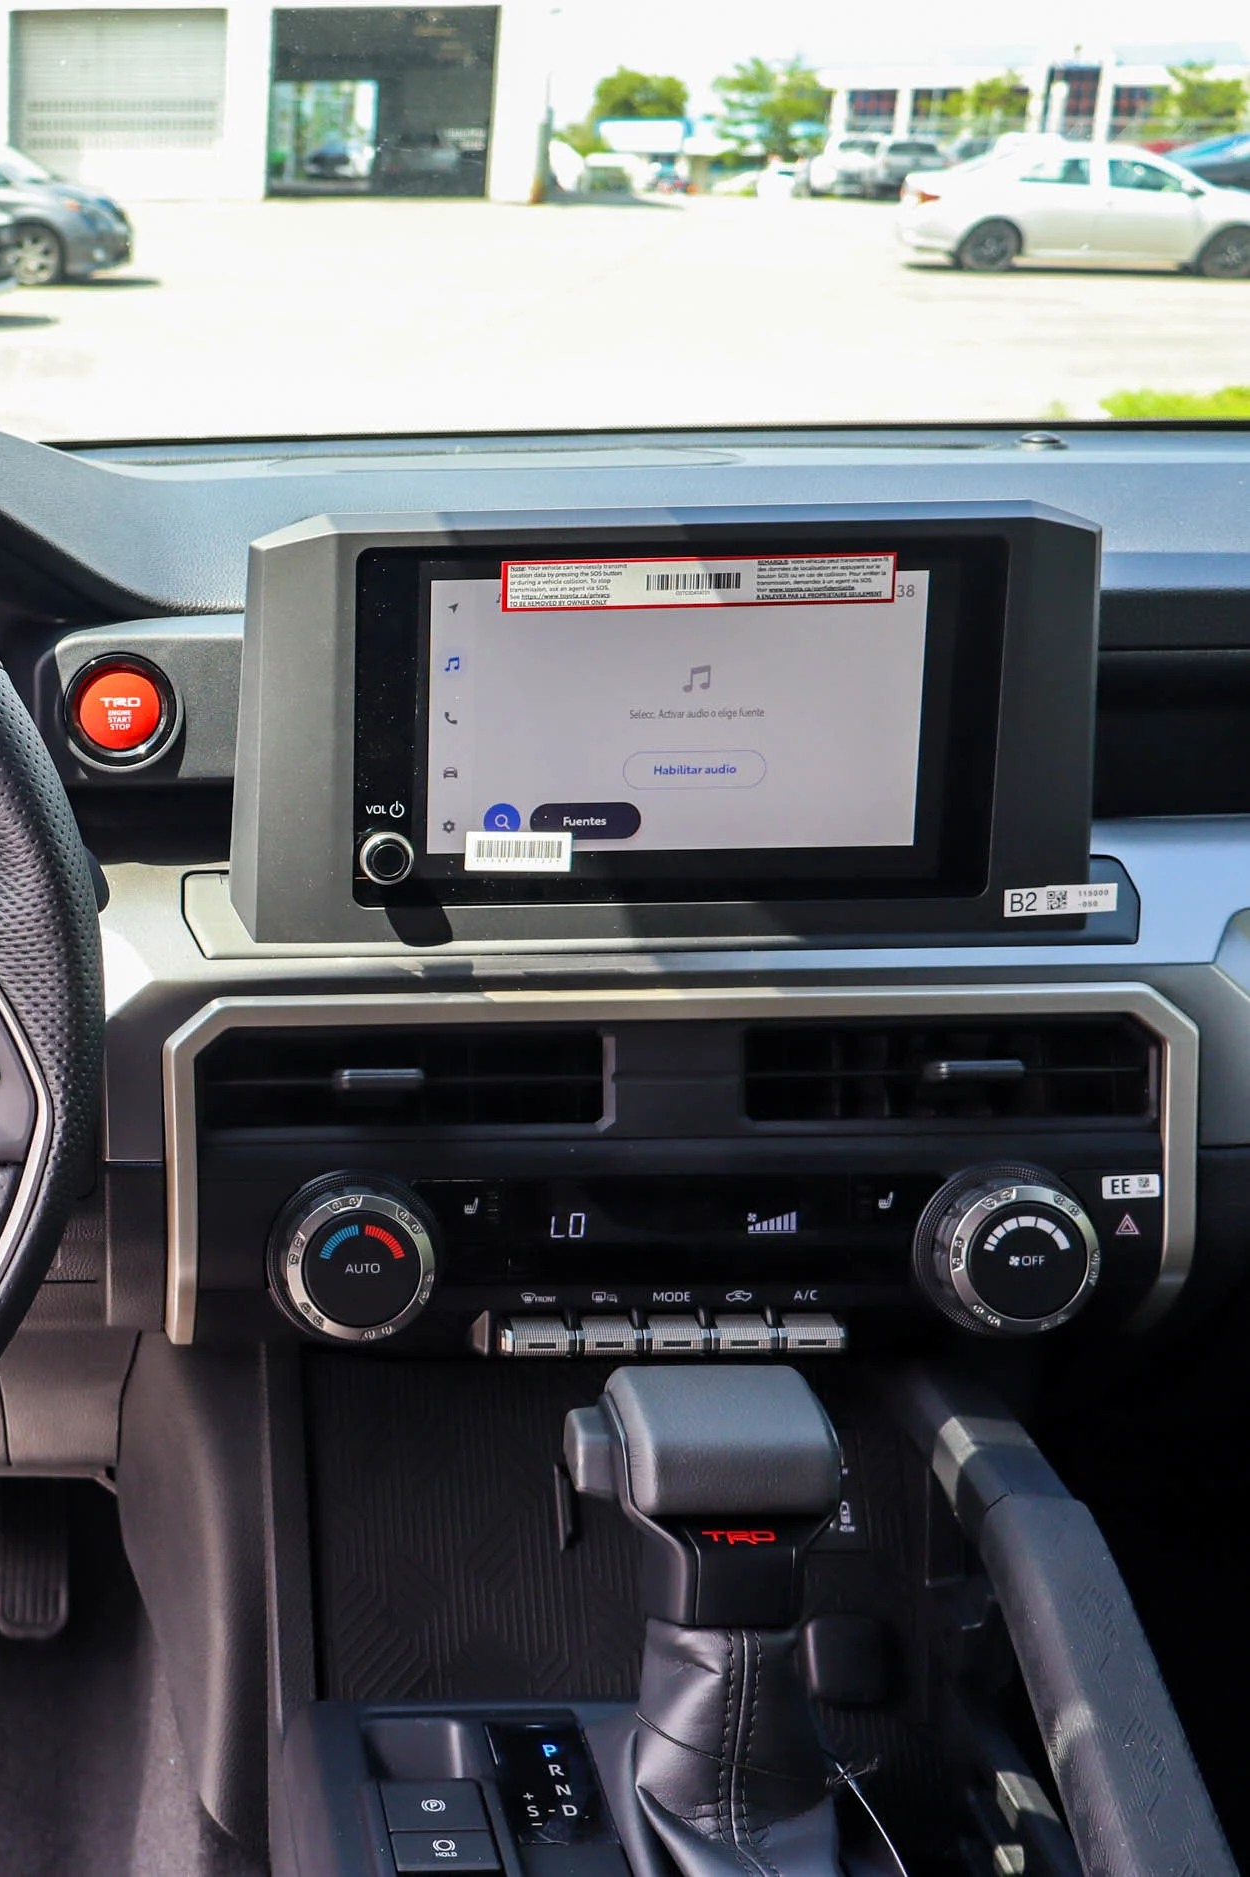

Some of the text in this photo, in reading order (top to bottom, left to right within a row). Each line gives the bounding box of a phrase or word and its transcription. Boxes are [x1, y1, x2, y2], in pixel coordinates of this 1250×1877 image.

[99, 697, 141, 708] TRD
[629, 709, 657, 720] Selecc.
[658, 708, 686, 719] Activar
[686, 707, 709, 718] audio
[718, 707, 737, 720] elige
[738, 707, 765, 718] fuente
[653, 763, 737, 776] Habilitar audio
[365, 804, 387, 815] VOL
[562, 816, 607, 827] Fuentes
[1010, 892, 1037, 912] B2
[1111, 1178, 1131, 1194] EE
[549, 1212, 587, 1239] LO
[1021, 1255, 1046, 1267] OFF
[344, 1263, 381, 1274] AUTO
[535, 1295, 556, 1303] FRONT
[652, 1291, 691, 1303] MODE
[794, 1289, 818, 1301] A/C
[701, 1530, 777, 1545] TRD
[542, 1744, 558, 1757] P
[548, 1764, 565, 1777] R
[555, 1784, 572, 1796] N
[527, 1804, 578, 1817] S D
